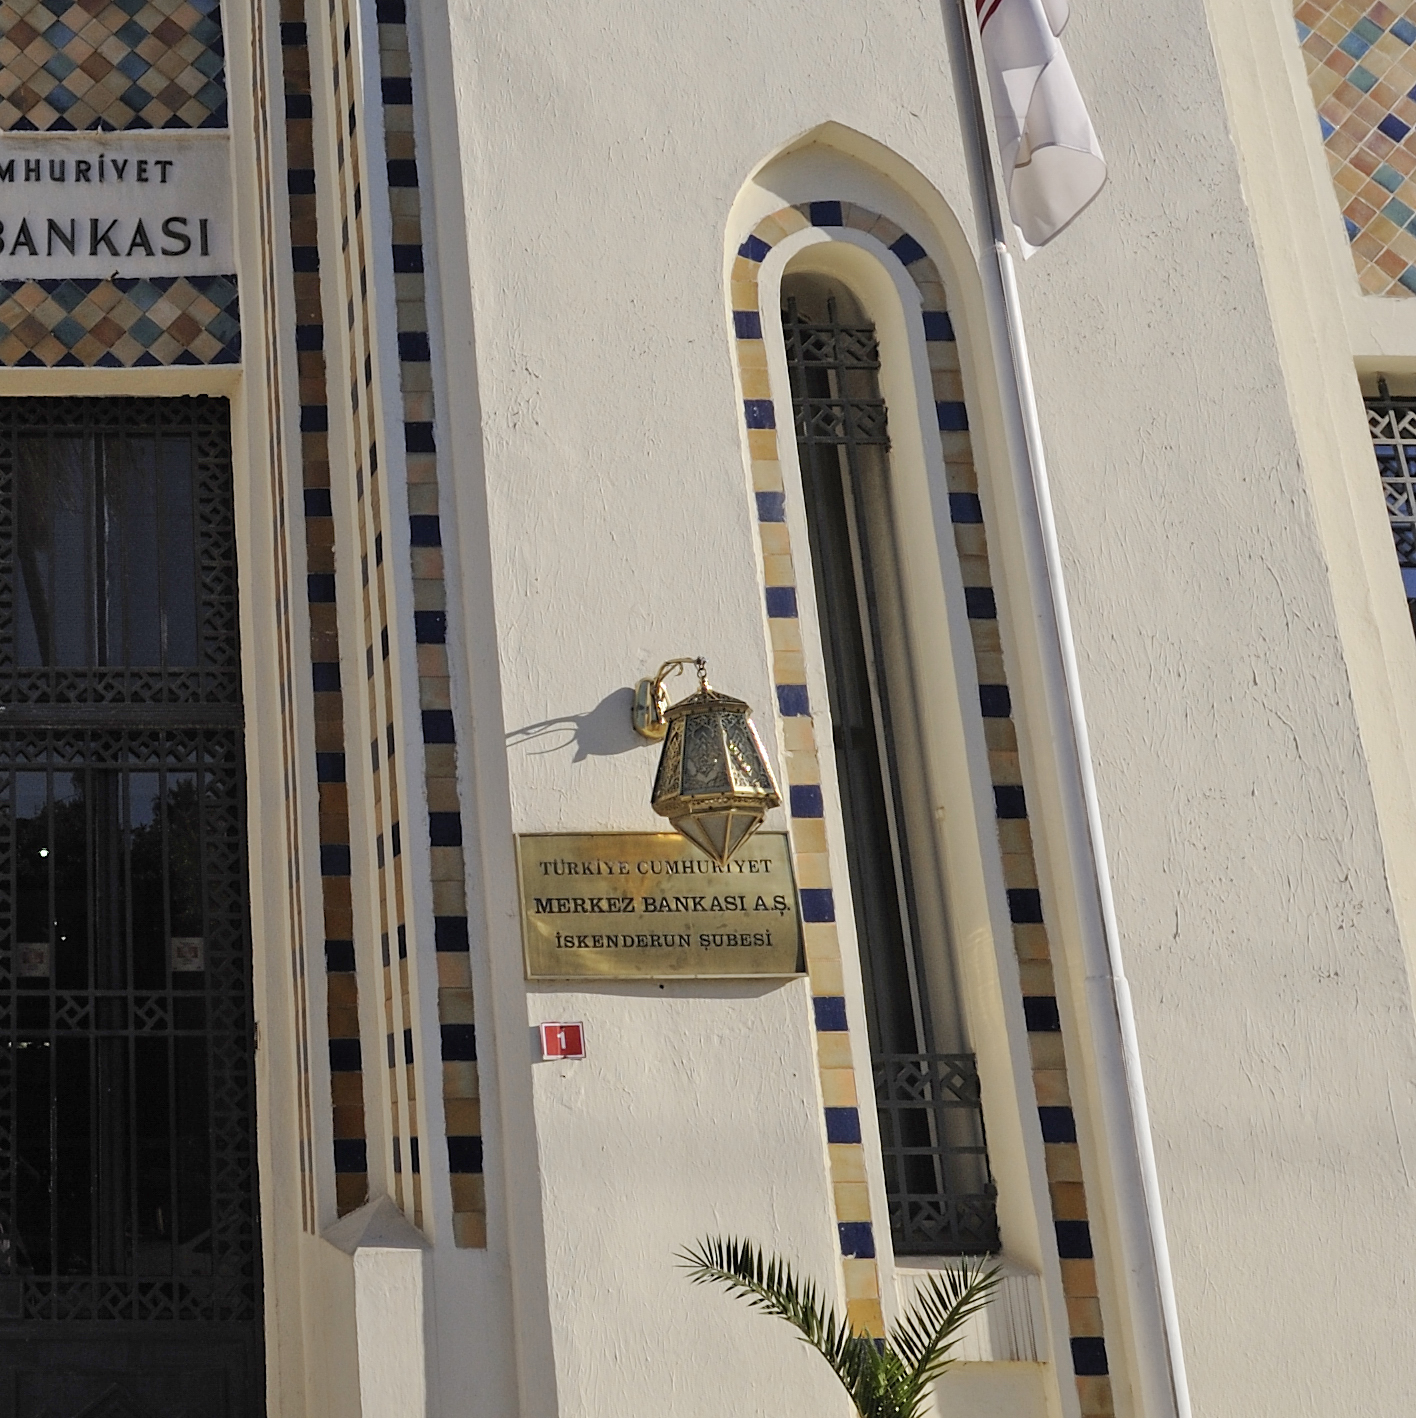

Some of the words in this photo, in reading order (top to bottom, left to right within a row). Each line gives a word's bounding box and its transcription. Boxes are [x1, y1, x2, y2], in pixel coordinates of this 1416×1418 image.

[539, 859, 630, 876] TÜRKİYE
[534, 897, 635, 914] MERKEZ
[642, 896, 746, 913] BANKASI
[752, 895, 791, 916] A.Ş.
[555, 932, 691, 949] İSKENDERUN
[699, 929, 773, 951] ŞUBESİ
[557, 1031, 567, 1050] 1
